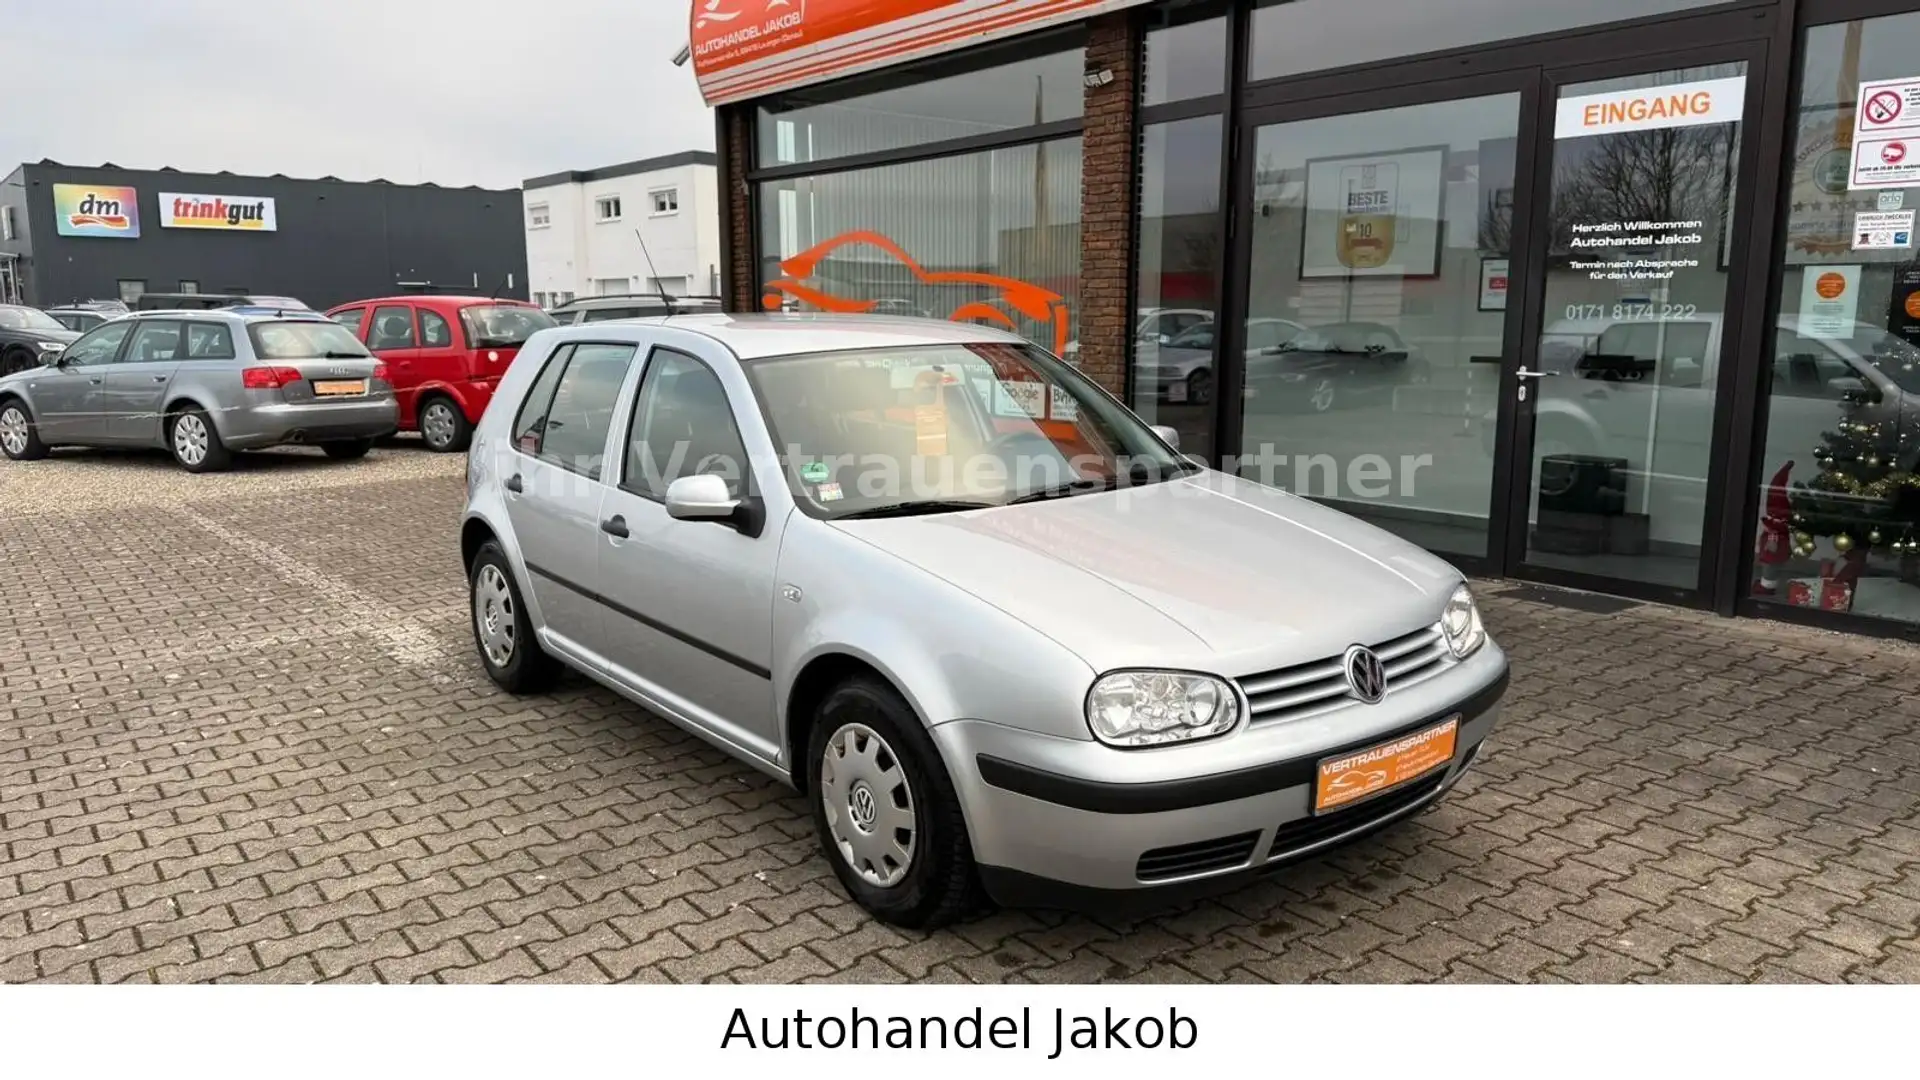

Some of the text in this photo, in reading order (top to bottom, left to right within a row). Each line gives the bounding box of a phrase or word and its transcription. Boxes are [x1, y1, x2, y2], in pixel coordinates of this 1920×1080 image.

[695, 25, 762, 56] AUTOHANDEL
[763, 11, 801, 35] JAKOB
[1583, 91, 1711, 126] EINGANG
[79, 194, 120, 216] dm
[1348, 190, 1389, 206] BESTE
[172, 197, 265, 226] trinkgut
[1571, 220, 1703, 233] Herzlich Willkommen
[1569, 232, 1703, 248] Autohandel Jakob
[1569, 258, 1699, 270] Termin nach Absprache
[1589, 270, 1675, 280] für den Verkauf
[1565, 302, 1697, 321] 0171 8174 222
[1322, 719, 1457, 776] VERTRAUENSPARTNER
